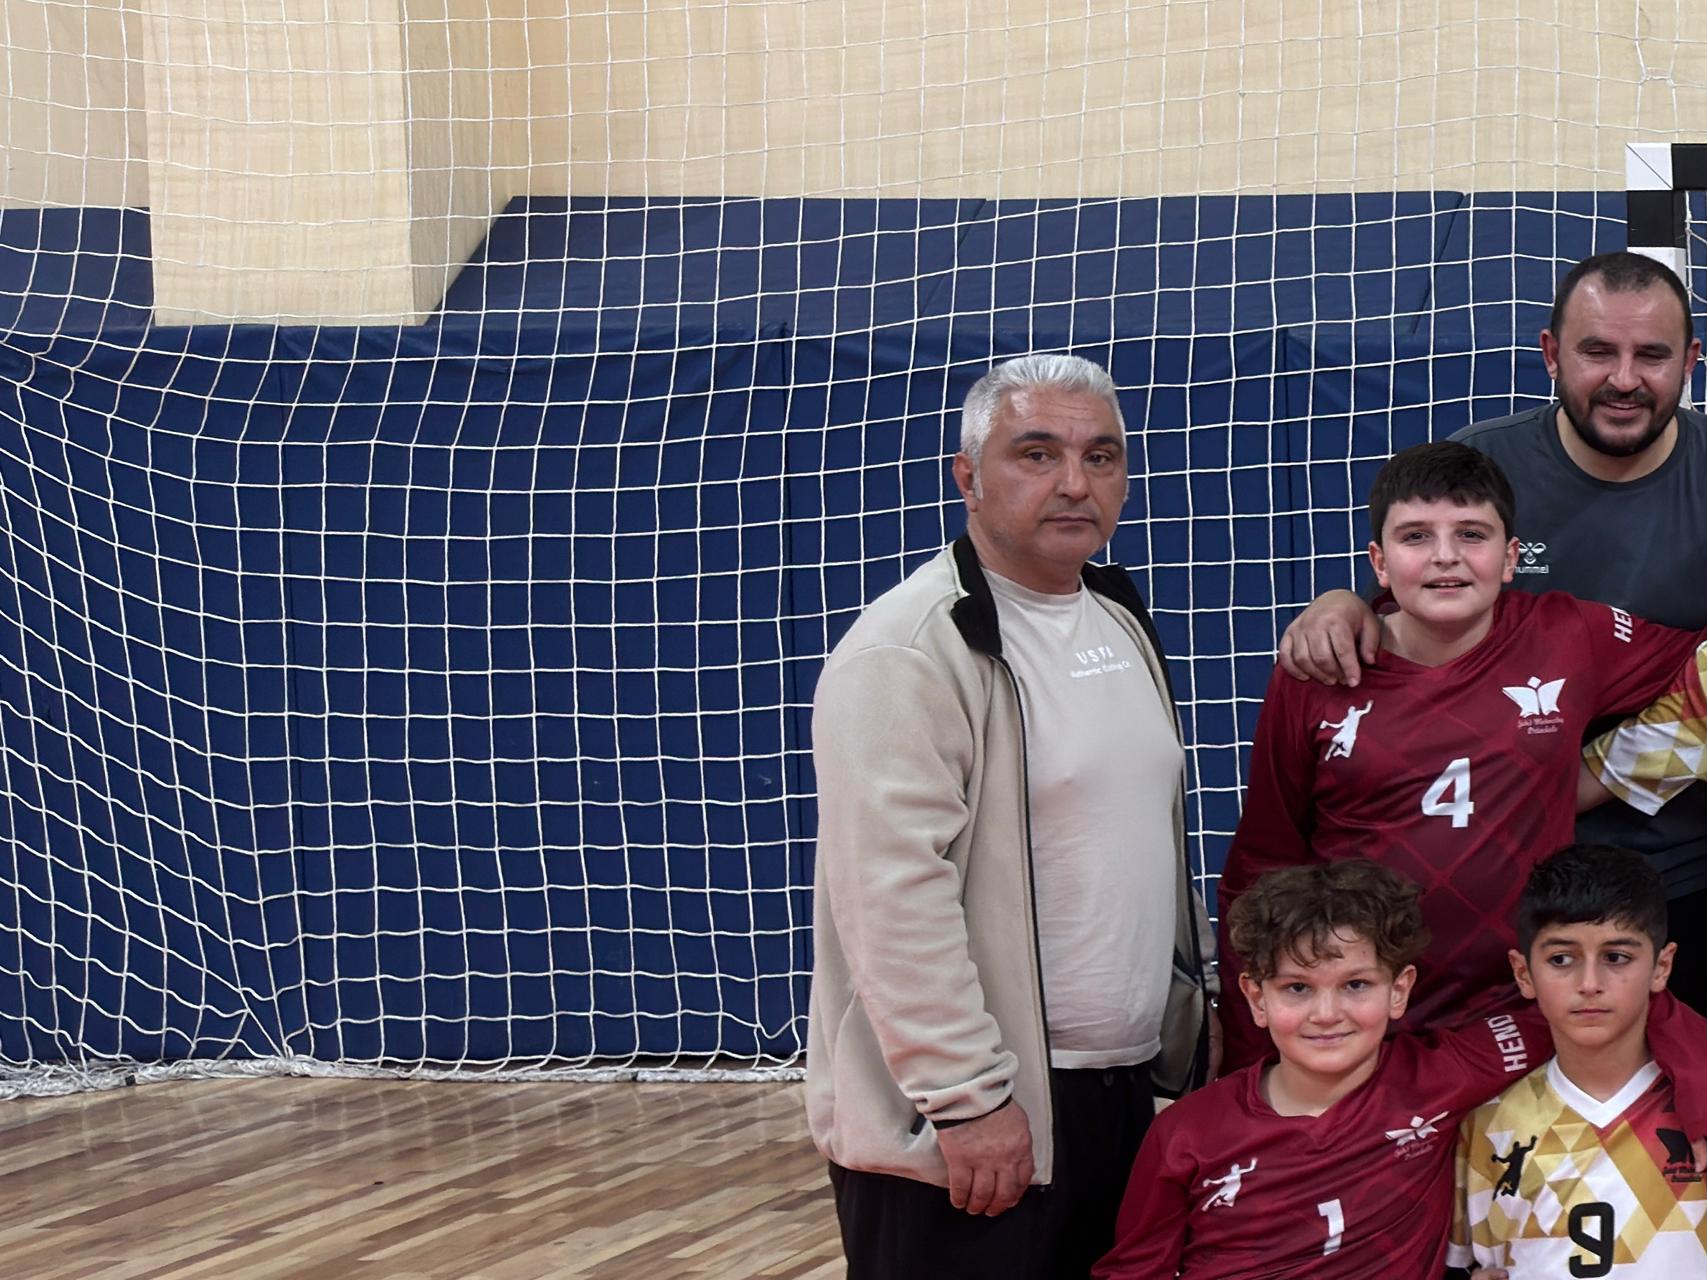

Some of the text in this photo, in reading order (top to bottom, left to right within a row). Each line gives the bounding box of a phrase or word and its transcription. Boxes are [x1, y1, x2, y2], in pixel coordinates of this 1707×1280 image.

[1421, 757, 1475, 829] 4
[1487, 1015, 1528, 1072] HEND
[1317, 1198, 1345, 1256] 1
[1567, 1202, 1614, 1279] 9
